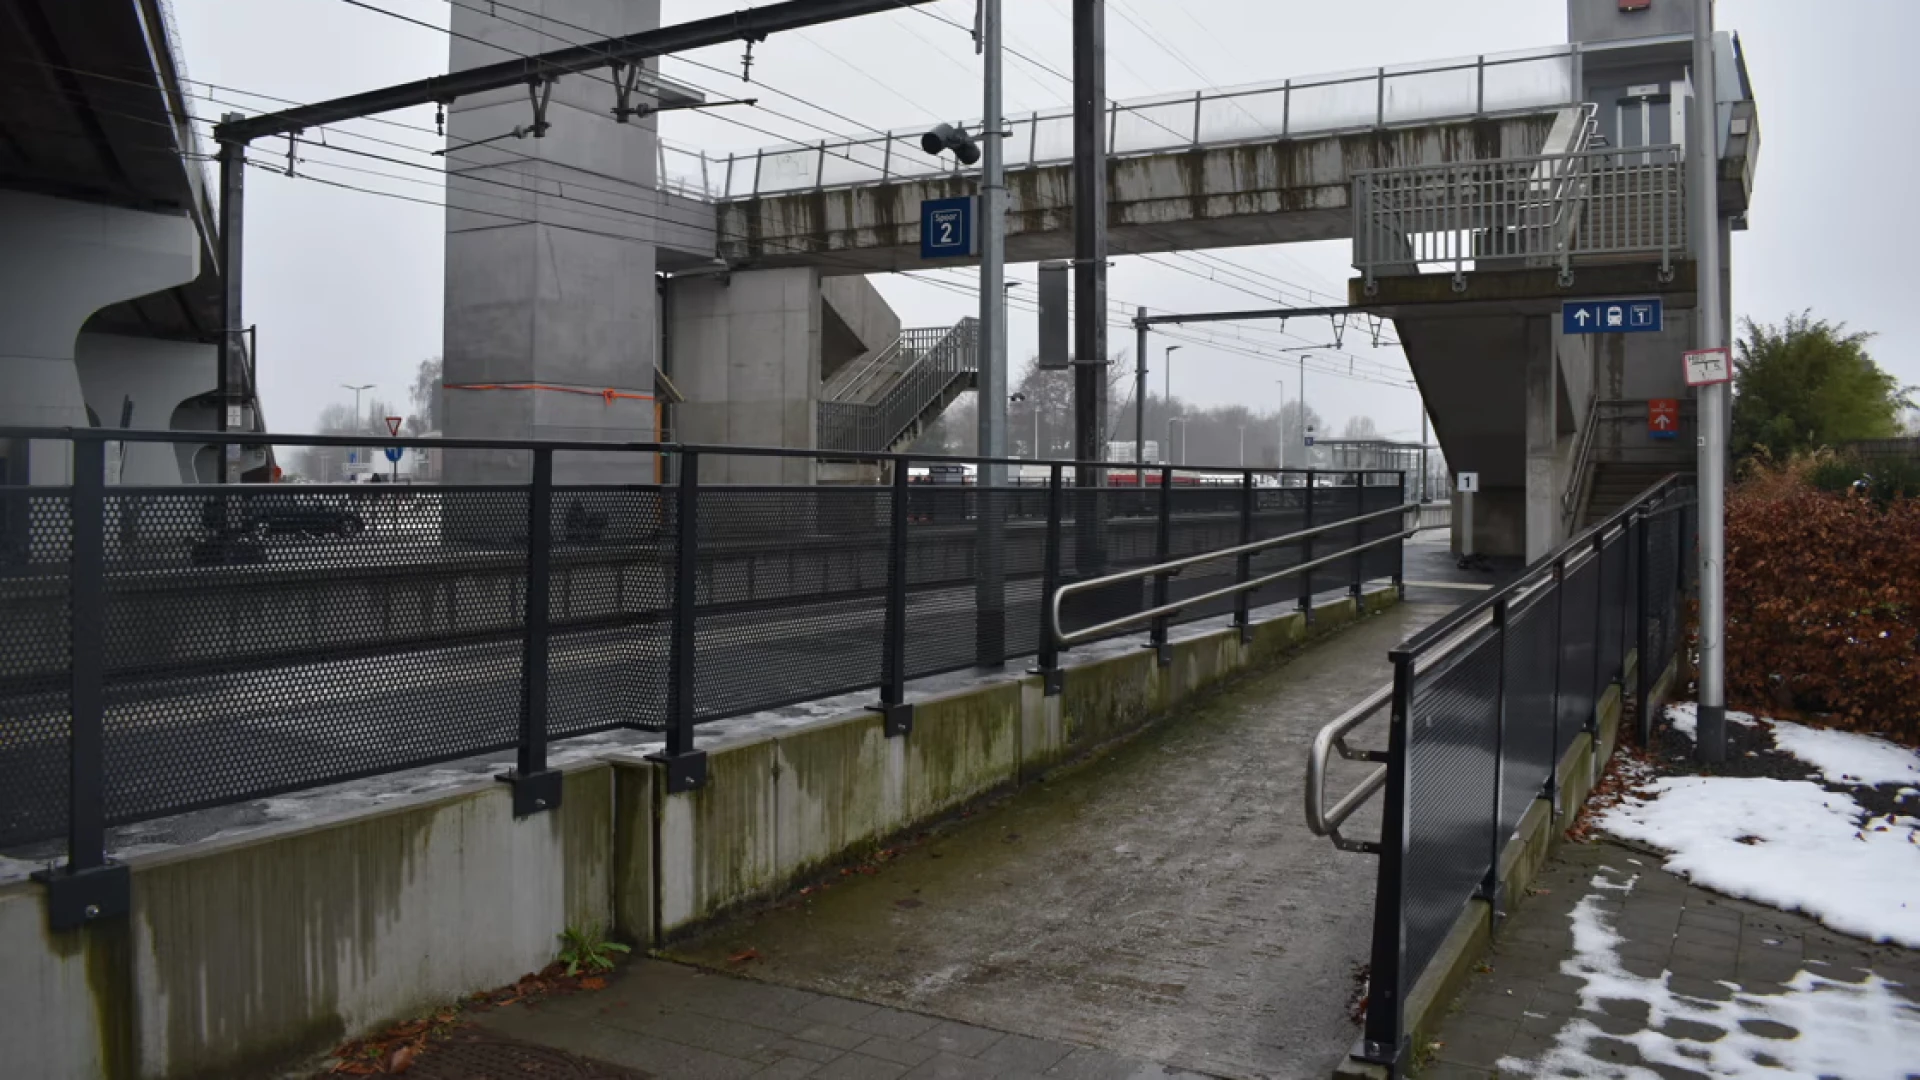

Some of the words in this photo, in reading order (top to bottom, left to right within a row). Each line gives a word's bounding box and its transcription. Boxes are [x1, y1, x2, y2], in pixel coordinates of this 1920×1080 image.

[935, 213, 957, 223] Spoor
[940, 222, 952, 243] 2
[1637, 311, 1645, 324] 1
[1463, 476, 1470, 488] 1
